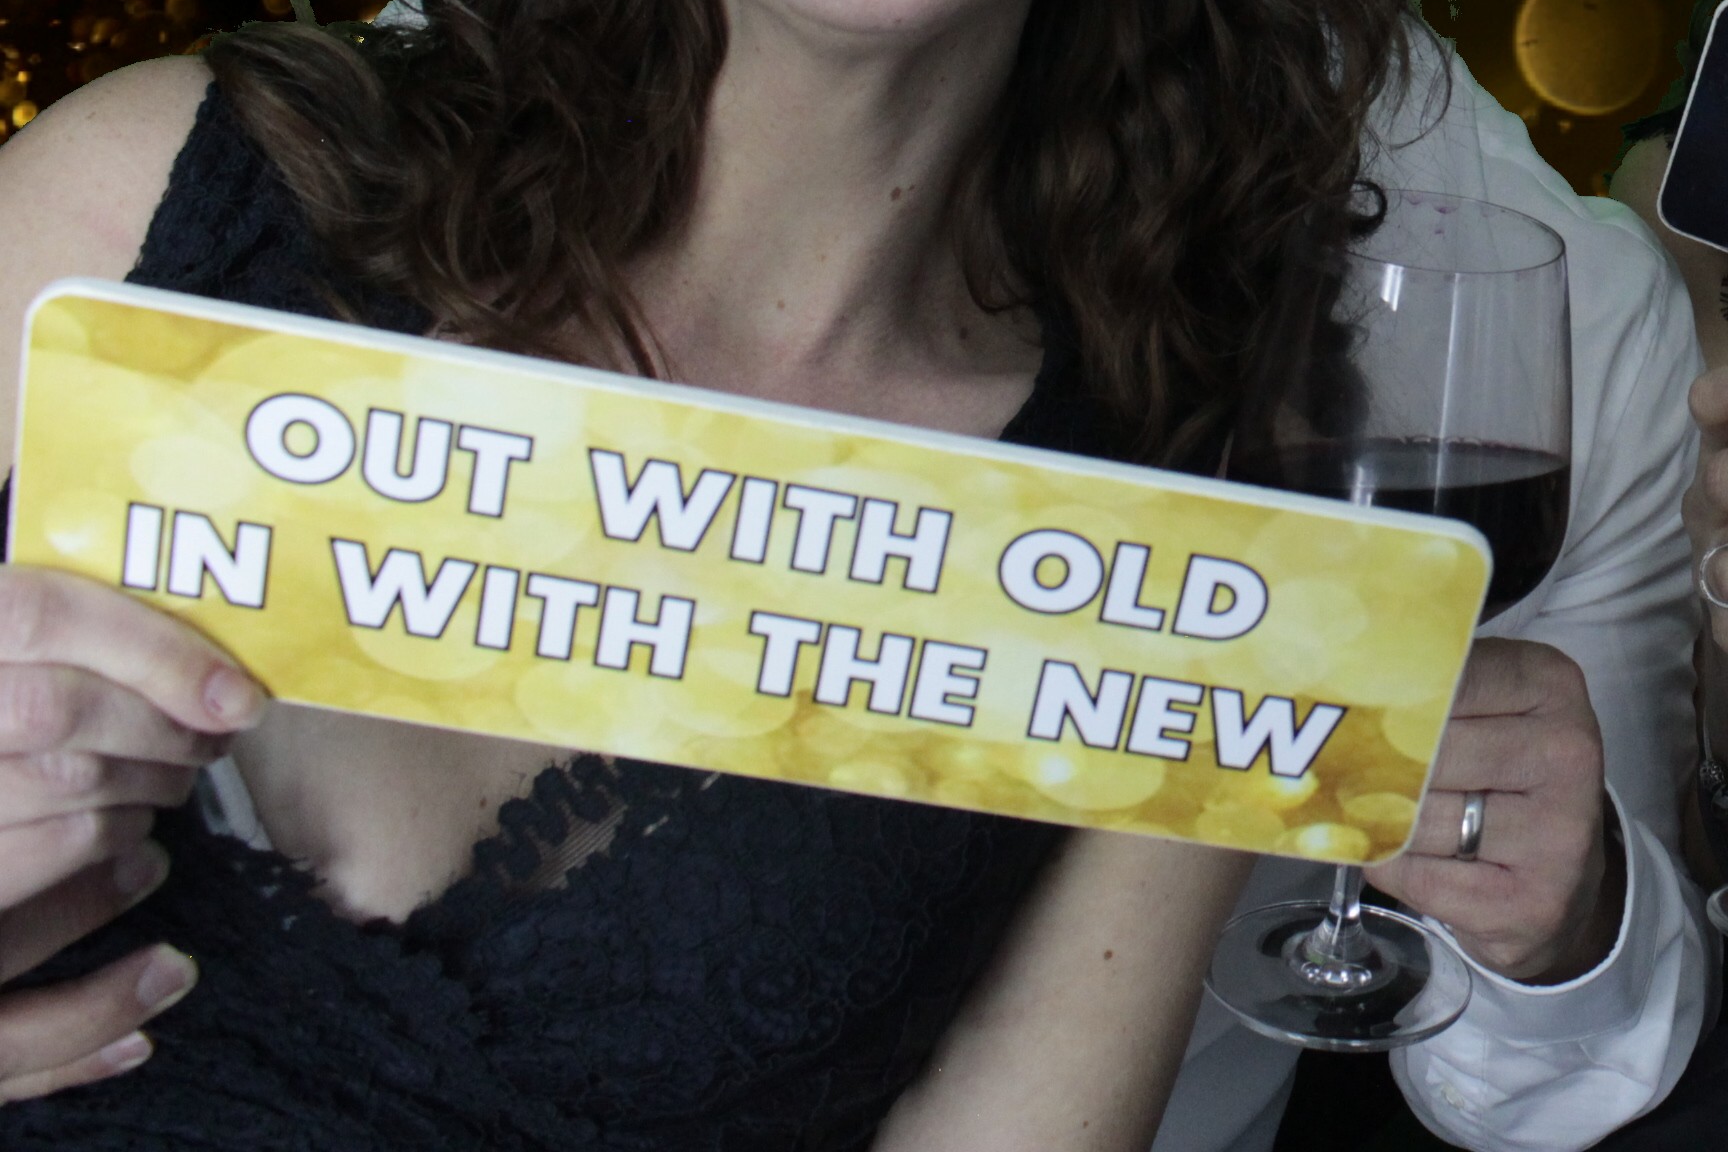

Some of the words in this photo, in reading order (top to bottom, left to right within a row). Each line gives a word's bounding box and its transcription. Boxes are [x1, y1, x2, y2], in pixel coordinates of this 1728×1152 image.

[121, 501, 273, 609] IN
[328, 536, 696, 679] WITH
[748, 609, 989, 728] THE
[1026, 659, 1350, 781] NEW
[243, 390, 532, 519] OUT
[588, 447, 954, 593] WITH
[997, 527, 1271, 641] OLD
